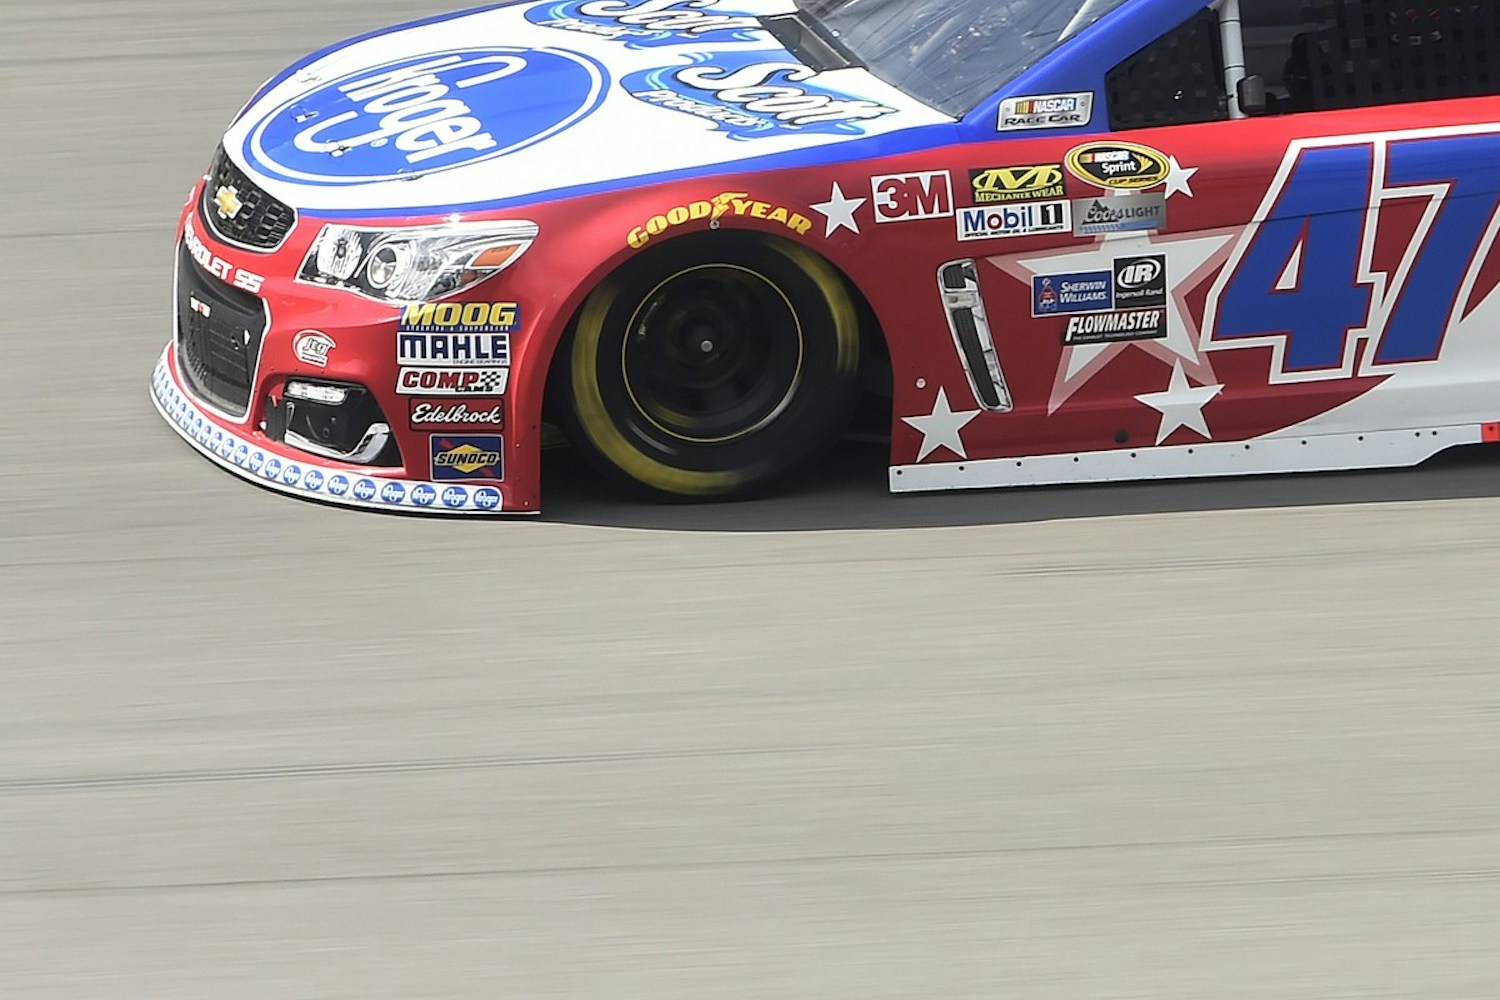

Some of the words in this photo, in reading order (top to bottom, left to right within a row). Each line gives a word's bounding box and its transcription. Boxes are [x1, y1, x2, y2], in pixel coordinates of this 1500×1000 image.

[677, 63, 900, 127] Scott
[294, 52, 528, 162] Kroger
[633, 90, 770, 128] Products
[1034, 97, 1076, 113] NASCAR
[1005, 116, 1045, 126] RACE
[1049, 114, 1081, 123] CAR
[1101, 161, 1137, 175] Sprint
[875, 176, 950, 218] 3M
[975, 190, 1032, 203] MECHANIX
[1032, 186, 1064, 199] WEAR
[627, 192, 814, 249] GOODYEAR
[963, 206, 1033, 232] Mobil
[1042, 204, 1060, 225] 1
[1125, 206, 1161, 219] LIGHT
[233, 268, 265, 293] SS
[1124, 264, 1153, 284] IR
[1060, 280, 1107, 293] SHERWIN
[1116, 289, 1144, 299] Ingersoll
[1145, 287, 1163, 296] Rand
[1060, 291, 1108, 304] WILLIAMS
[401, 302, 518, 326] MOOG
[1065, 310, 1160, 342] FLOWMASTER
[400, 335, 507, 359] MAHLE
[403, 371, 480, 389] COMP
[412, 404, 501, 423] Edelbrock
[437, 454, 497, 465] SUNOCO
